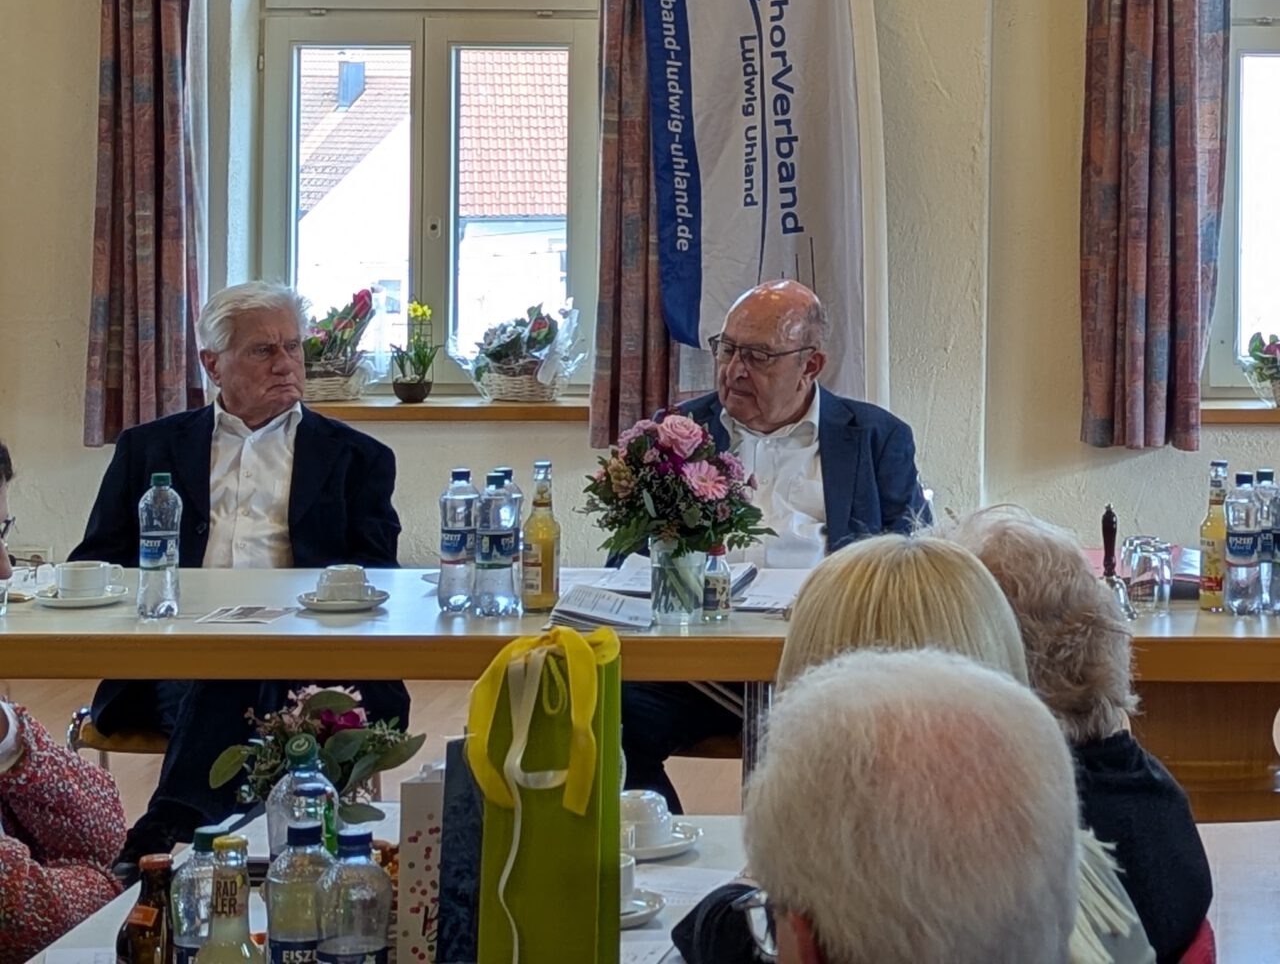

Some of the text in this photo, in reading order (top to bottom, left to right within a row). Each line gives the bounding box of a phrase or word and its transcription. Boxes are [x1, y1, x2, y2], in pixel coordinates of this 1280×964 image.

[739, 35, 759, 208] Ludwig Uhland
[216, 880, 237, 897] RAD
[215, 897, 238, 915] LER
